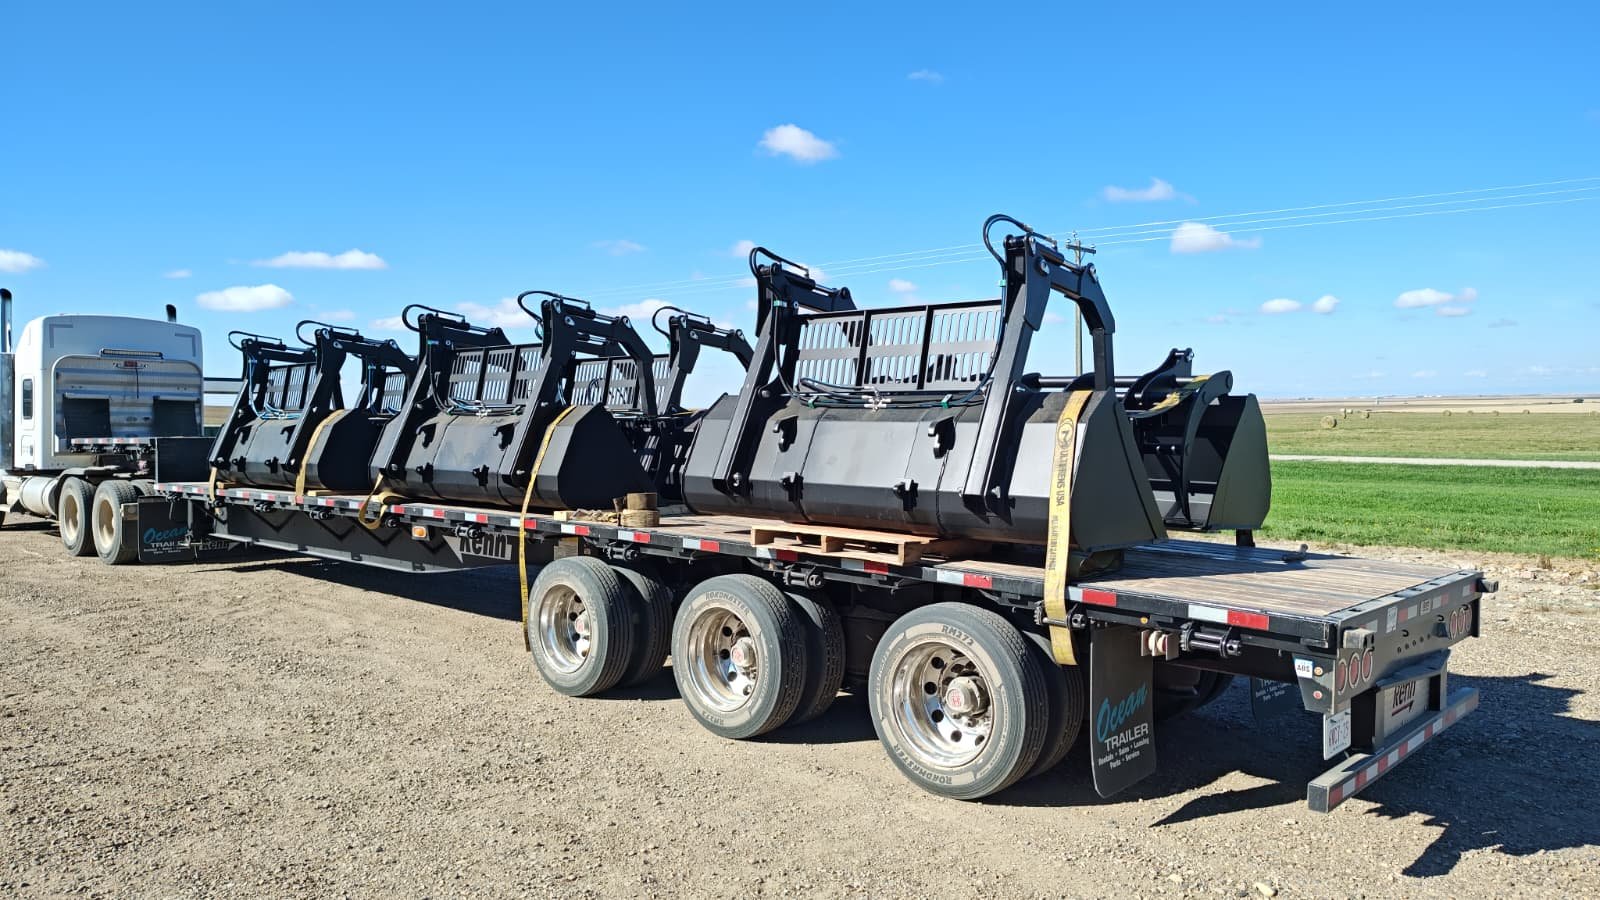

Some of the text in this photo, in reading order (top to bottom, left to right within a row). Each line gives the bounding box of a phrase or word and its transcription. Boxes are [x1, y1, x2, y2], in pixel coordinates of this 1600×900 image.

[1056, 491, 1065, 506] USA
[942, 624, 974, 646] RM272
[1096, 682, 1147, 743] Ocean
[1104, 723, 1149, 752] TRAILER
[894, 743, 953, 784] ROADMASTER
